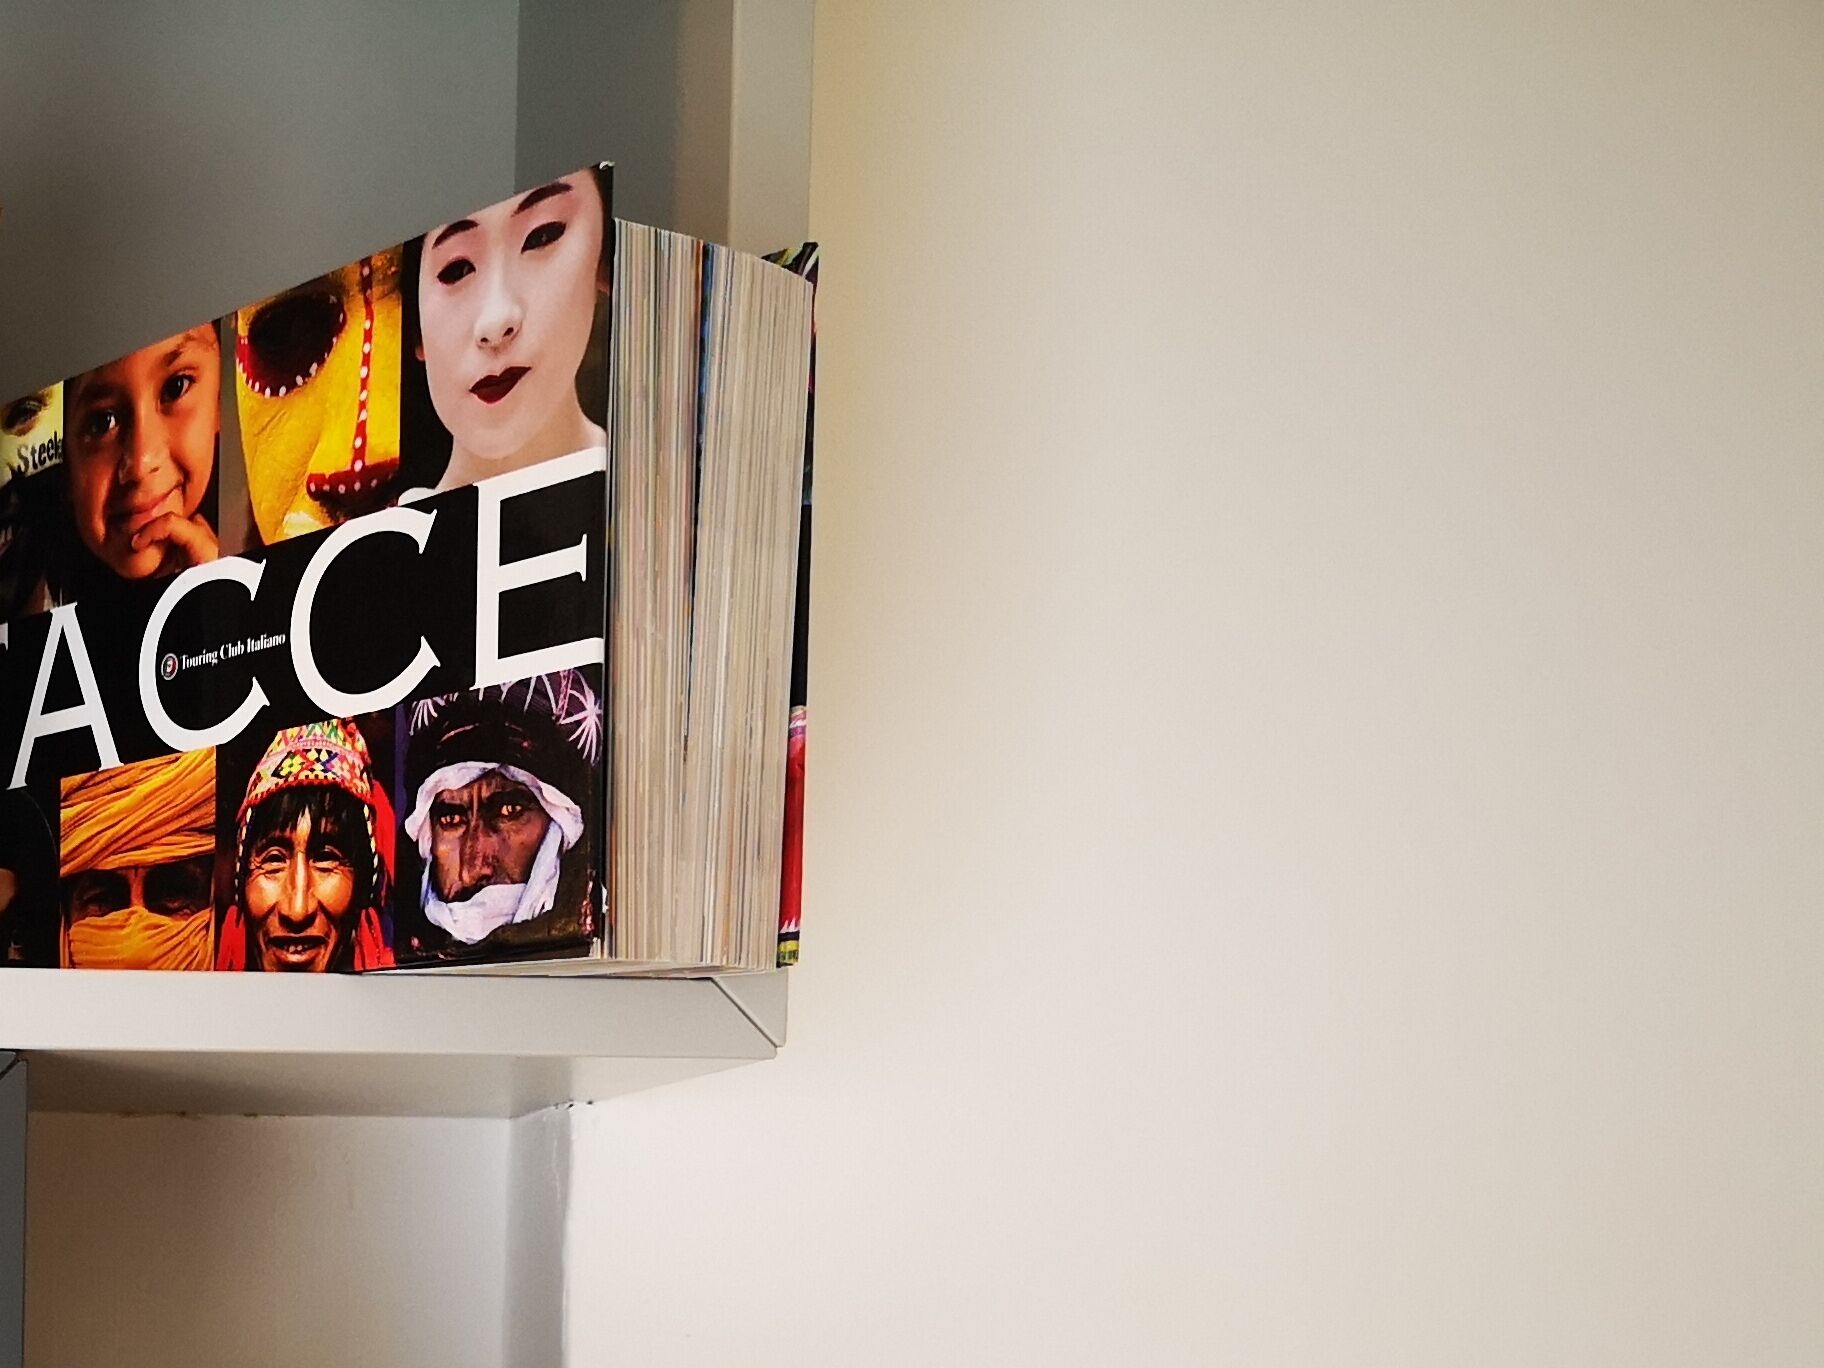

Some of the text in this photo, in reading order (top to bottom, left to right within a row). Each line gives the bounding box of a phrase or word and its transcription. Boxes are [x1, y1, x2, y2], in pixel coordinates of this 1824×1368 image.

[180, 632, 286, 670] Touring Club Italiano
